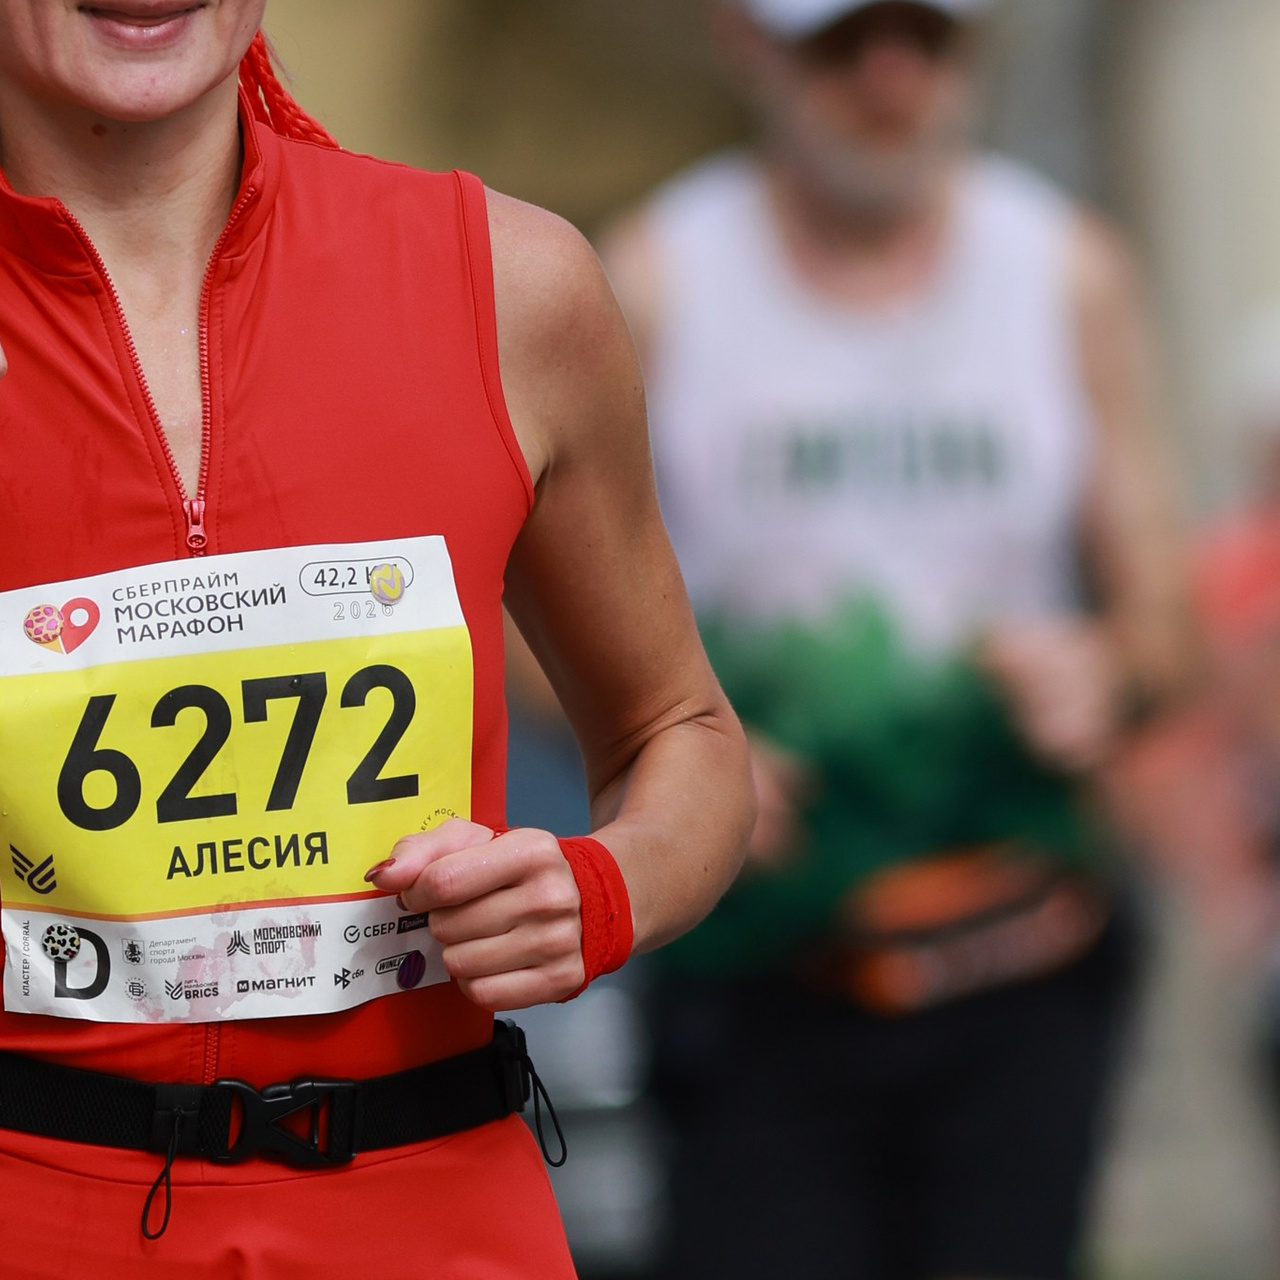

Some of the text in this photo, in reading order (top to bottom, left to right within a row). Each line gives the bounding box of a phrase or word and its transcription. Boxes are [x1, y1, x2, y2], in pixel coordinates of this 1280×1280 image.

[112, 572, 238, 601] СБЕРПРАЙМ
[314, 567, 357, 588] 42,2
[114, 583, 287, 623] МОСКОВСКИЙ
[117, 614, 244, 644] МАРАФОН
[57, 664, 419, 831] 6272
[166, 831, 329, 880] АЛЕСИЯ
[253, 920, 322, 941] МОСКОВСКИЙ
[363, 922, 396, 938] СБЕР
[254, 940, 286, 955] СПОРТ
[22, 958, 30, 996] КЛАСТЕР
[54, 926, 110, 1000] D
[184, 987, 219, 1000] BRICS
